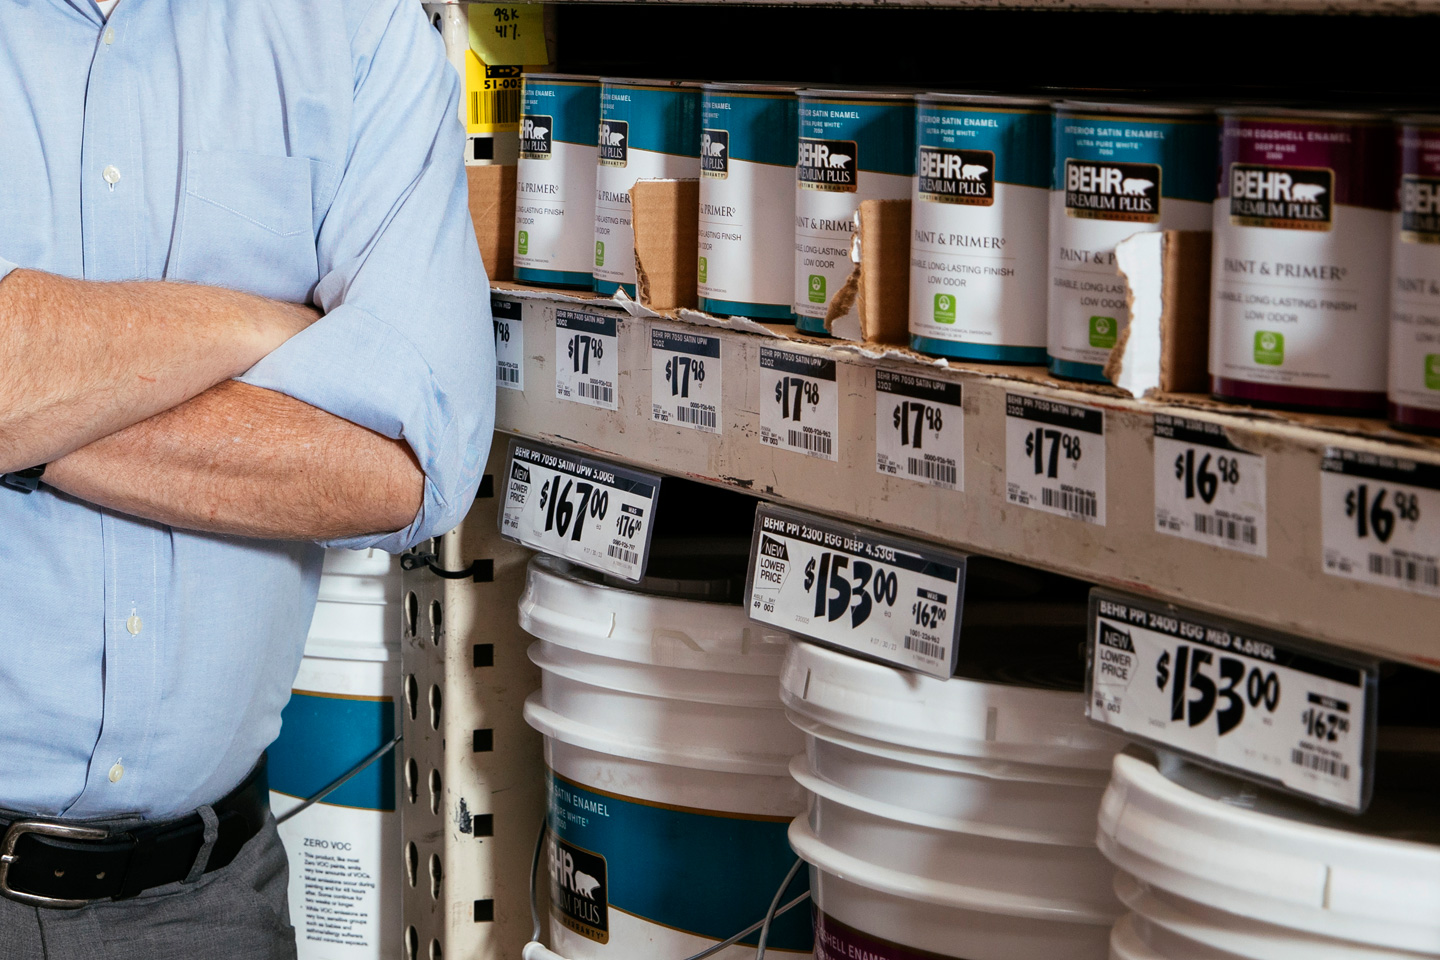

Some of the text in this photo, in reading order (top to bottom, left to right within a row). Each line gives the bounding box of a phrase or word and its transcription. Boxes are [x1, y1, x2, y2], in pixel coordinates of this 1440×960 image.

[964, 119, 998, 127] ENAMEL
[1125, 129, 1164, 138] ENAMEL
[1255, 130, 1304, 140] EGGSHELL
[799, 143, 829, 168] BEHR
[921, 151, 962, 179] BEHR
[827, 170, 850, 183] PLUS
[1069, 165, 1123, 194] BEHR
[959, 181, 985, 195] PLUS
[1234, 170, 1292, 200] BEHR
[1068, 193, 1151, 211] PREMIUM PLUS
[1288, 201, 1324, 219] PLUS
[1061, 247, 1090, 262] PAINT
[928, 262, 981, 274] LONG-LASTING
[761, 348, 773, 357] BEHR
[783, 352, 794, 361] 7050
[515, 447, 615, 483] BEHR PPI 7050 SATIN UPW 5.00GL
[514, 468, 529, 479] NEW
[511, 482, 528, 494] LOWER
[510, 493, 525, 504] PRICE
[764, 517, 896, 562] BEHR PPI 2300 EGG DEEP 4.53GL
[765, 543, 784, 557] NEW
[760, 558, 785, 573] LOWER
[760, 570, 781, 584] PRICE
[764, 604, 774, 613] 003
[1100, 601, 1126, 619] BEHR
[1130, 610, 1147, 625] PPI
[1150, 614, 1177, 633] 2400
[1180, 623, 1203, 639] EGG
[1207, 629, 1230, 646] MED
[1105, 632, 1128, 647] NEW
[1101, 650, 1131, 667] LOWER
[1102, 662, 1128, 680] PRICE
[573, 795, 609, 817] ENAMEL
[304, 838, 351, 850] ZERO VOC
[574, 895, 600, 924] PLUS
